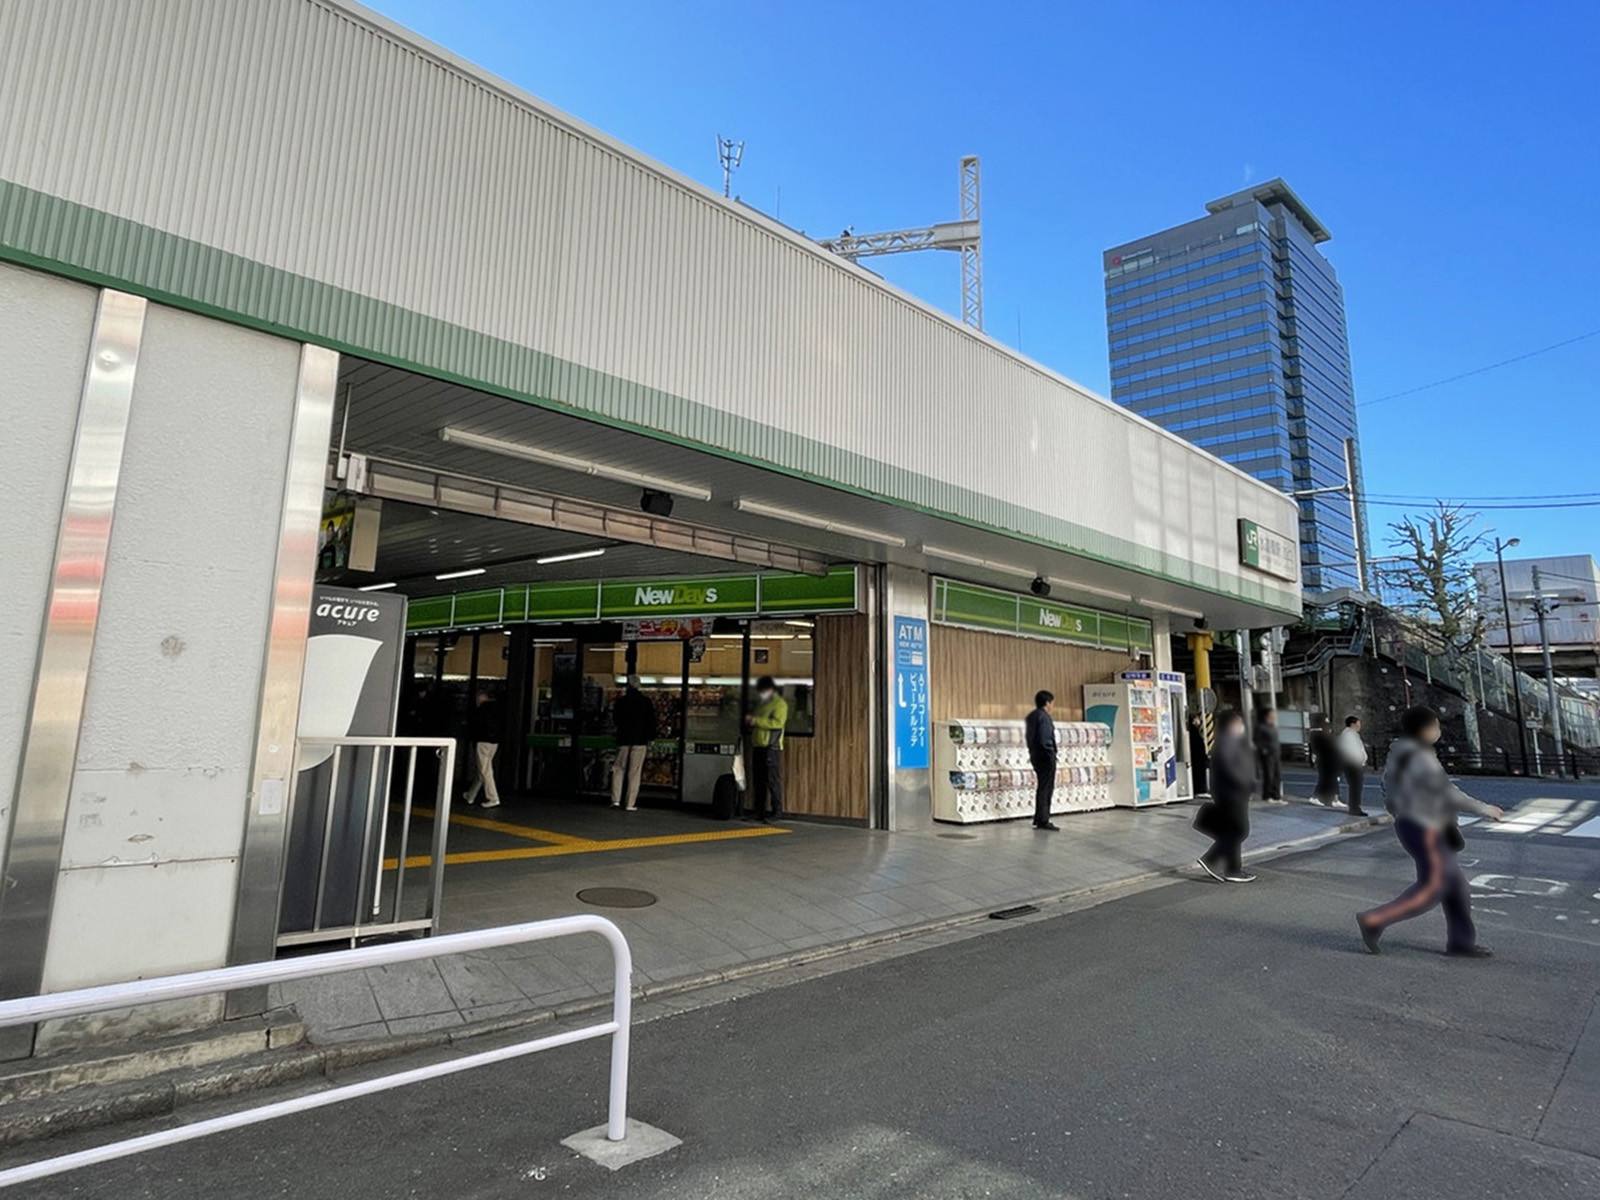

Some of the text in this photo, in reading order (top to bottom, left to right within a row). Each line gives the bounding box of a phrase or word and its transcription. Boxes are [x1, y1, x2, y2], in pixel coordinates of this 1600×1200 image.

[1246, 530, 1257, 546] JR
[634, 586, 718, 606] NewDays
[316, 603, 379, 621] acure
[899, 625, 923, 641] ATM
